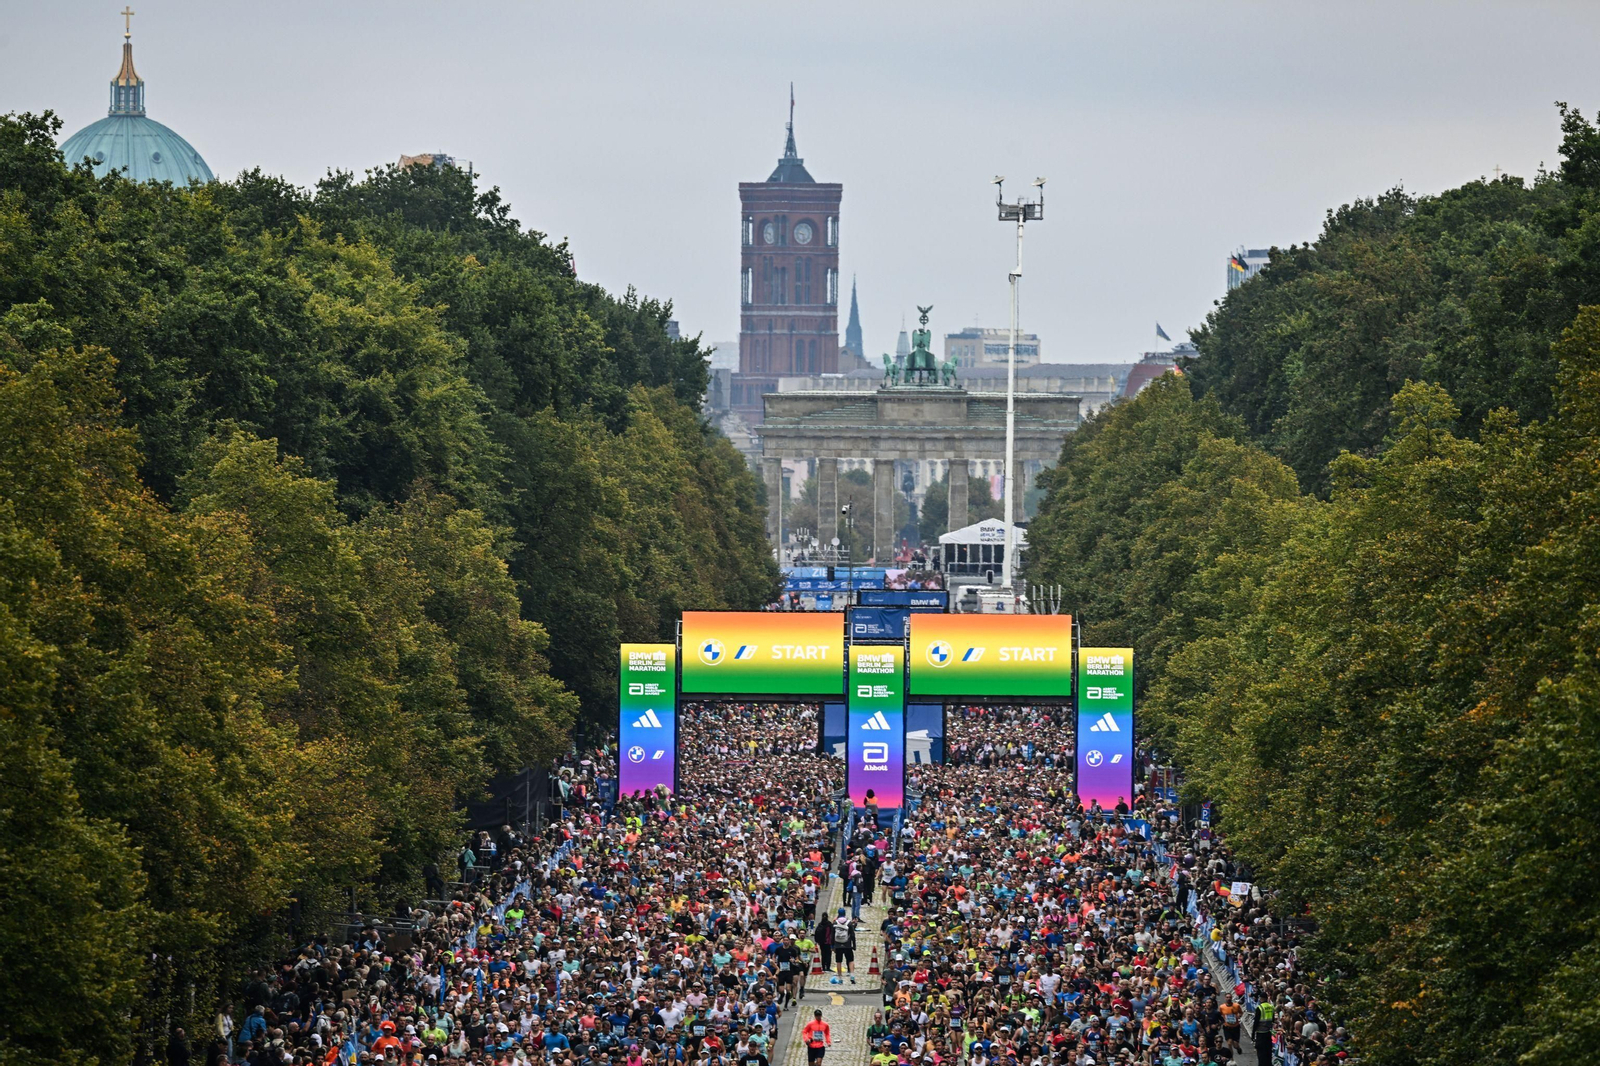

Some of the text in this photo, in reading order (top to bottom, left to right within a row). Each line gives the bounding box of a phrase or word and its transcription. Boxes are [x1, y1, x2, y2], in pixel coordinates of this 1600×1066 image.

[771, 645, 830, 660] START
[857, 654, 880, 662] BMW
[999, 647, 1058, 662] START
[1087, 656, 1110, 664] BMW
